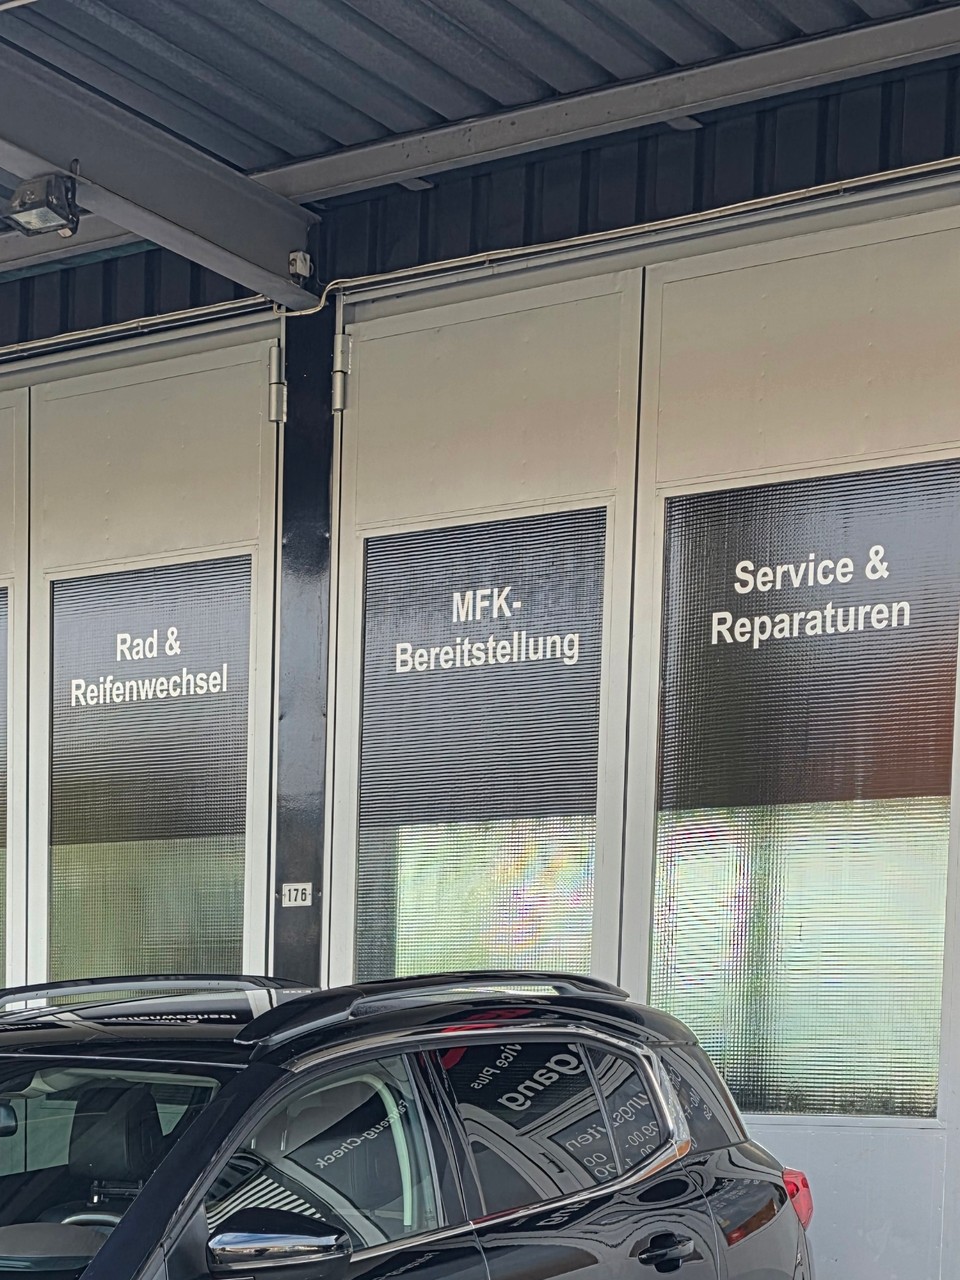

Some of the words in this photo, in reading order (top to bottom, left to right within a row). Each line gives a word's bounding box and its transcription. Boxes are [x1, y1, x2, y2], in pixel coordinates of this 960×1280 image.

[734, 551, 854, 594] Service
[864, 544, 890, 580] &
[452, 586, 522, 623] MFK-
[711, 601, 911, 649] Reparaturen
[116, 629, 158, 662] Rad
[164, 626, 182, 656] &
[395, 630, 580, 674] Bereitstellung
[70, 662, 228, 707] Reifenwechsel
[287, 887, 307, 902] 176
